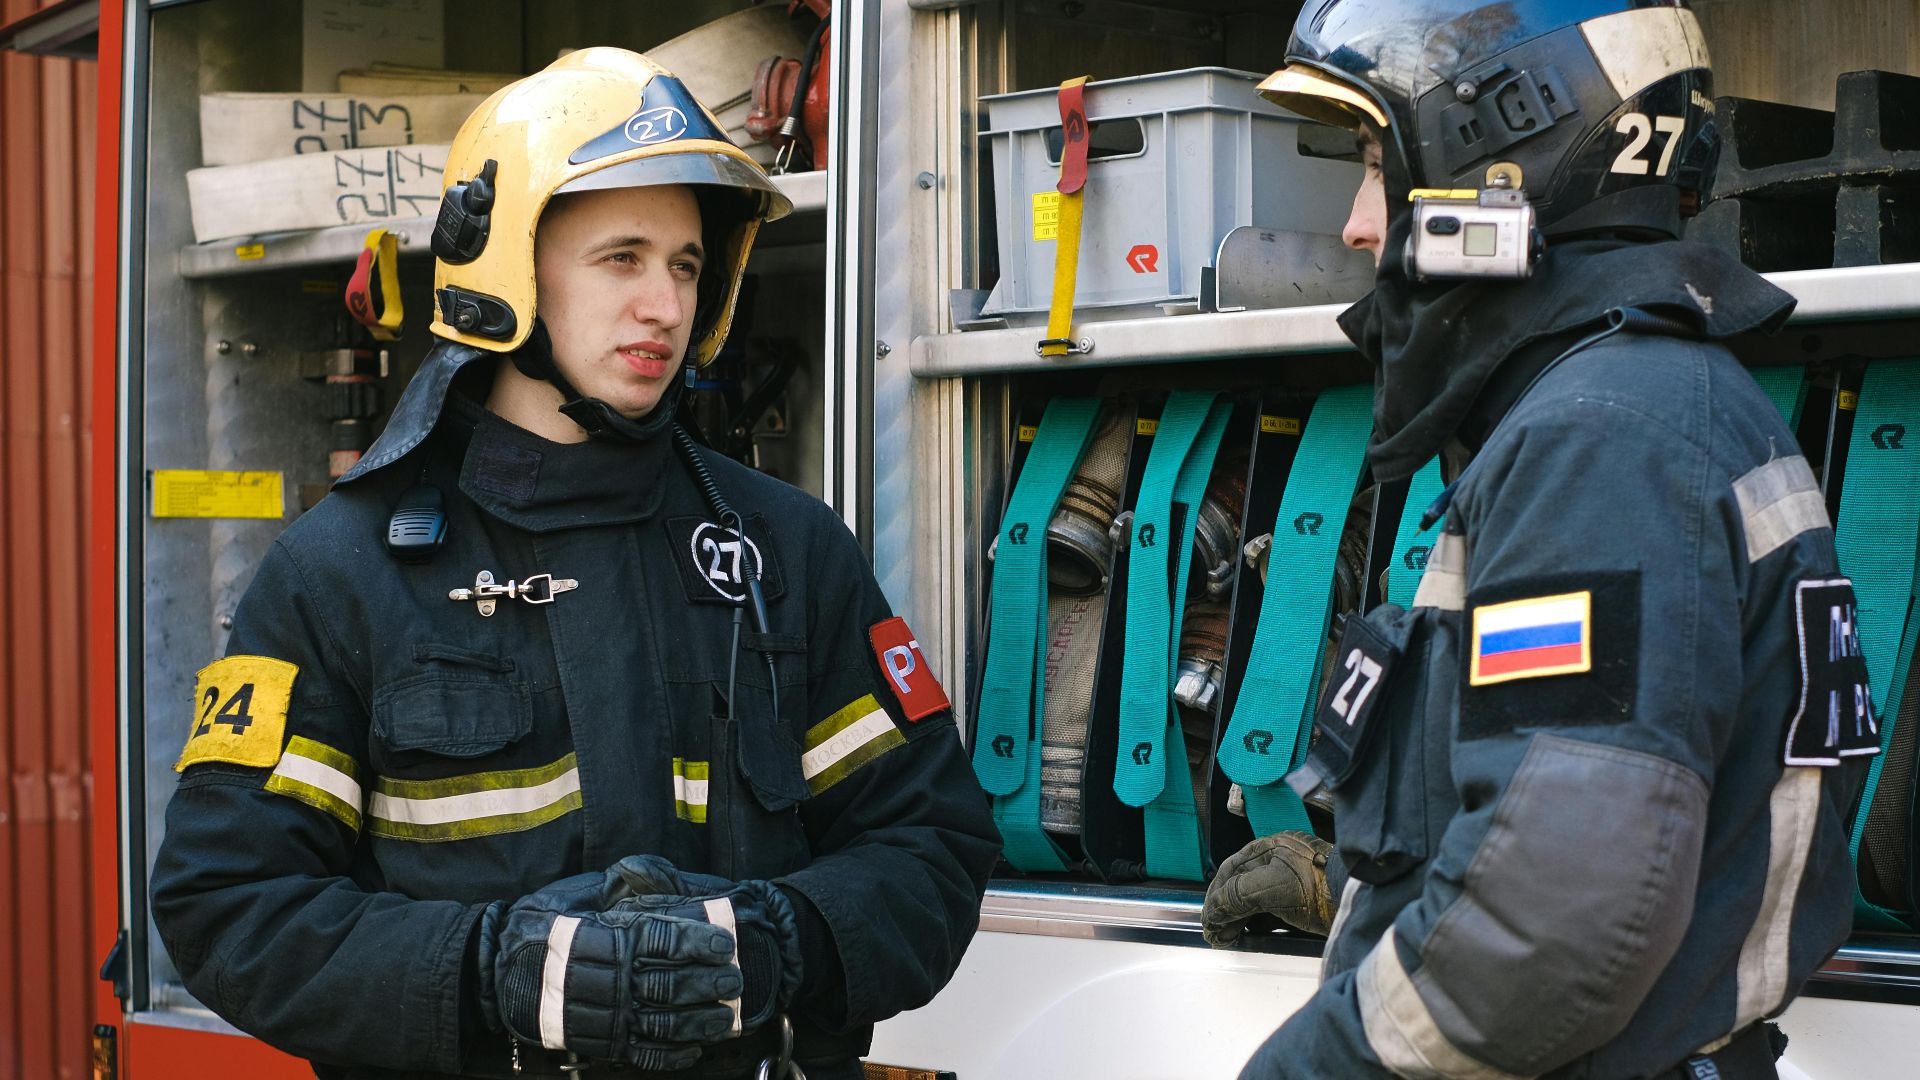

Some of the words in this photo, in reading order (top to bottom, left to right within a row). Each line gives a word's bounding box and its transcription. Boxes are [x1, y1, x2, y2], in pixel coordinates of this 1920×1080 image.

[633, 110, 674, 140] 27
[1610, 112, 1685, 177] 27
[335, 154, 389, 222] 27
[394, 150, 443, 217] 17
[702, 537, 742, 584] 27
[883, 639, 920, 694] Р
[1331, 648, 1383, 727] 27
[191, 683, 255, 741] 24
